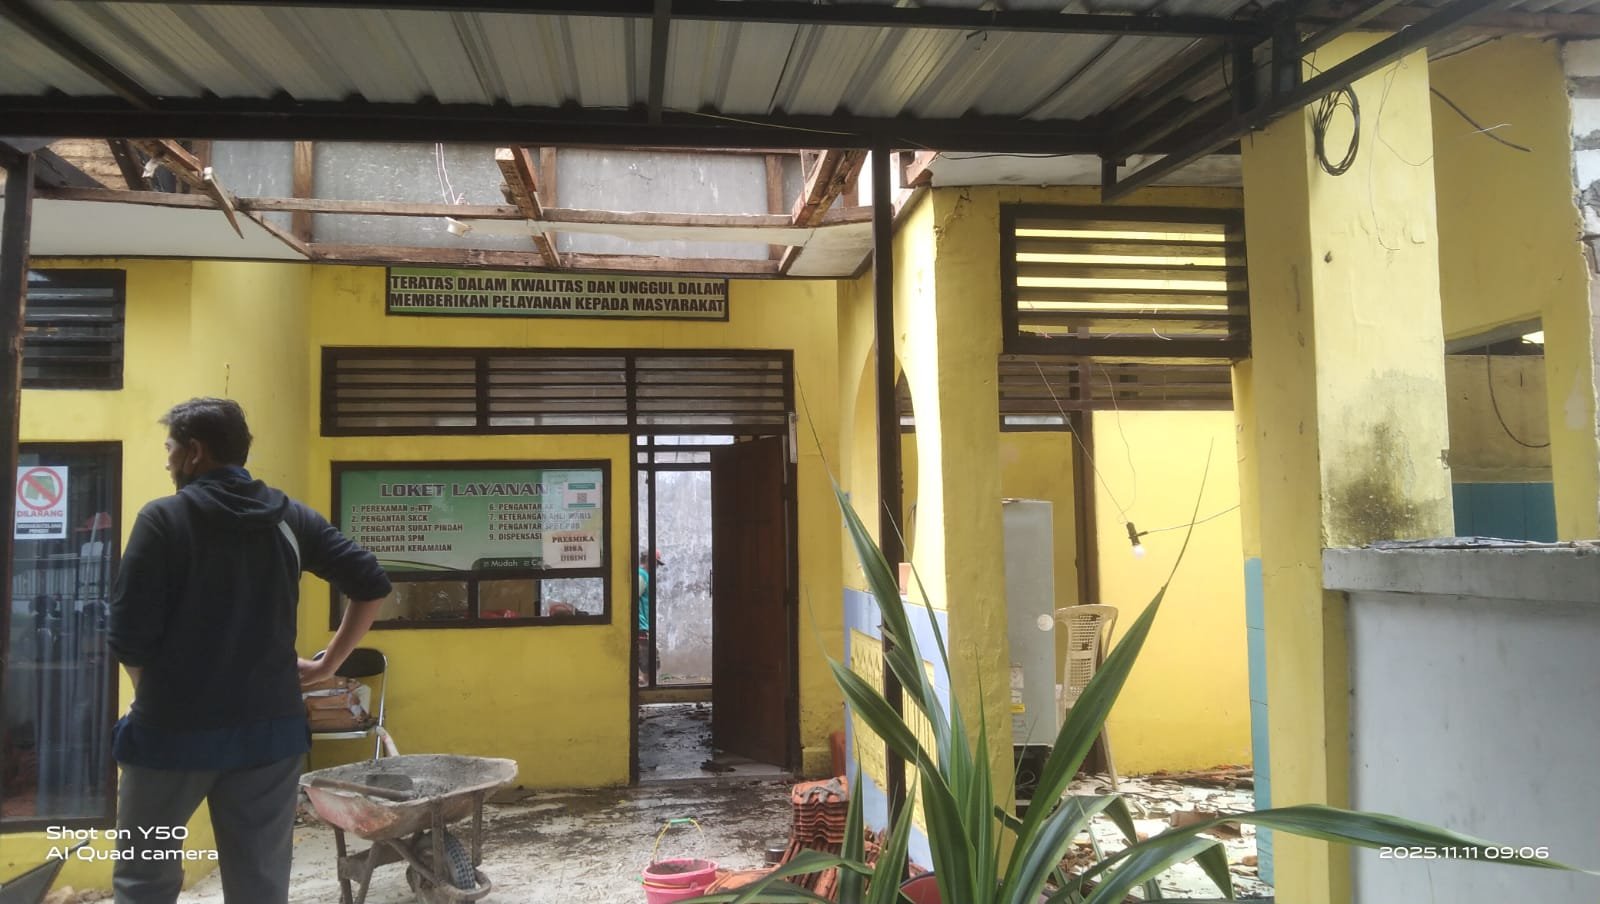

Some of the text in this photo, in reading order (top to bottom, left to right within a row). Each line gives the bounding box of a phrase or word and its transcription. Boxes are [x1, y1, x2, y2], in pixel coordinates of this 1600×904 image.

[391, 276, 726, 296] TERATAS DALAM KWALITAS DAN UNGGUL DALAM
[390, 293, 725, 312] MEMBERIKAN PELAYANAN KEPADA MASYARAKAT
[381, 484, 446, 497] LOKET
[452, 483, 548, 497] LAYANAN
[361, 505, 408, 513] PEREKAMAN
[498, 503, 542, 511] PENGANTAR
[361, 515, 406, 523] PENGANTAR
[407, 514, 429, 522] SKCK
[498, 513, 545, 521] KETERANGAN
[361, 525, 406, 533] PENGANTAR
[407, 524, 432, 532] SURAT
[434, 524, 463, 532] PINDAH
[498, 523, 542, 531] PENGANTAR
[361, 535, 406, 543] PENGANTAR
[407, 534, 425, 542] SPM
[498, 533, 542, 541] DISPENSASI
[491, 559, 518, 567] Mudah
